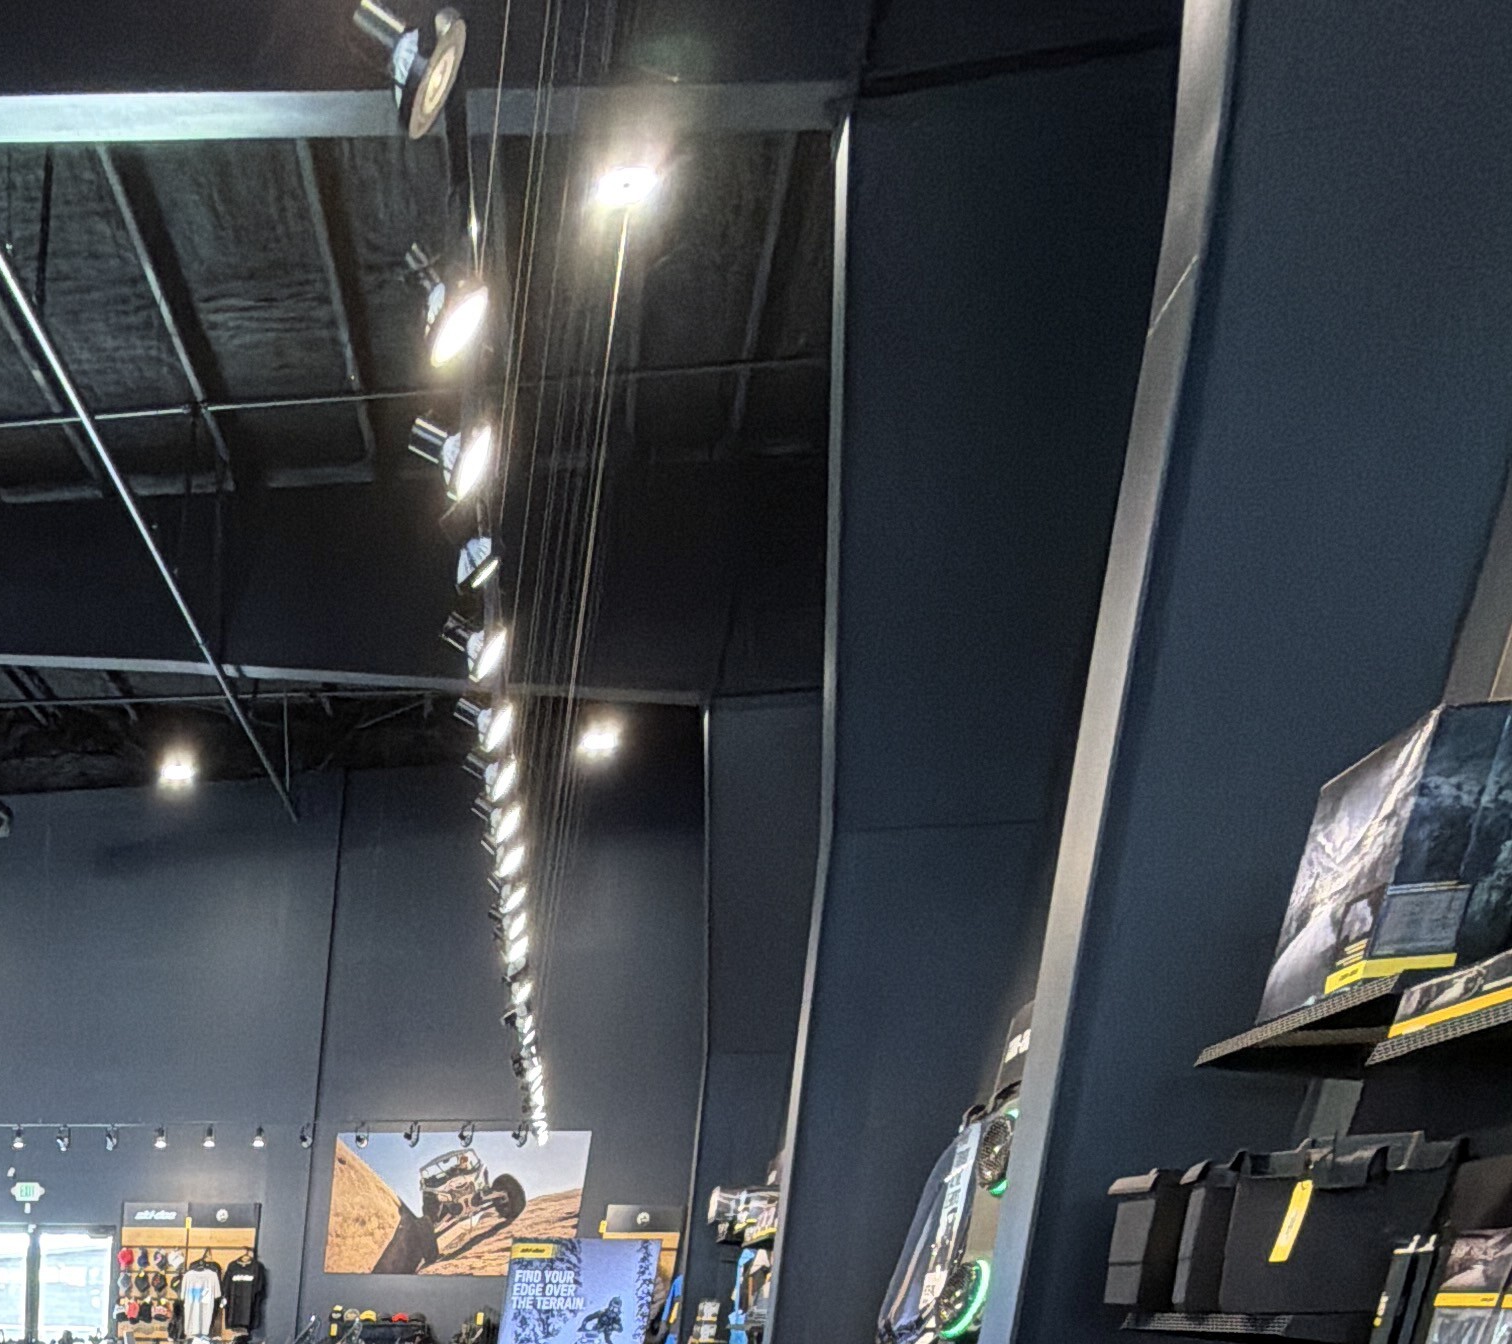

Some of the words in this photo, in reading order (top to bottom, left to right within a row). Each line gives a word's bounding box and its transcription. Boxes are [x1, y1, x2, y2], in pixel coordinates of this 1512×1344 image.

[19, 1184, 35, 1198] EXIT
[514, 1269, 542, 1284] FIND
[544, 1270, 575, 1284] YOUR
[513, 1284, 543, 1297] EDGE
[545, 1284, 576, 1297] OVER
[511, 1297, 534, 1310] THE
